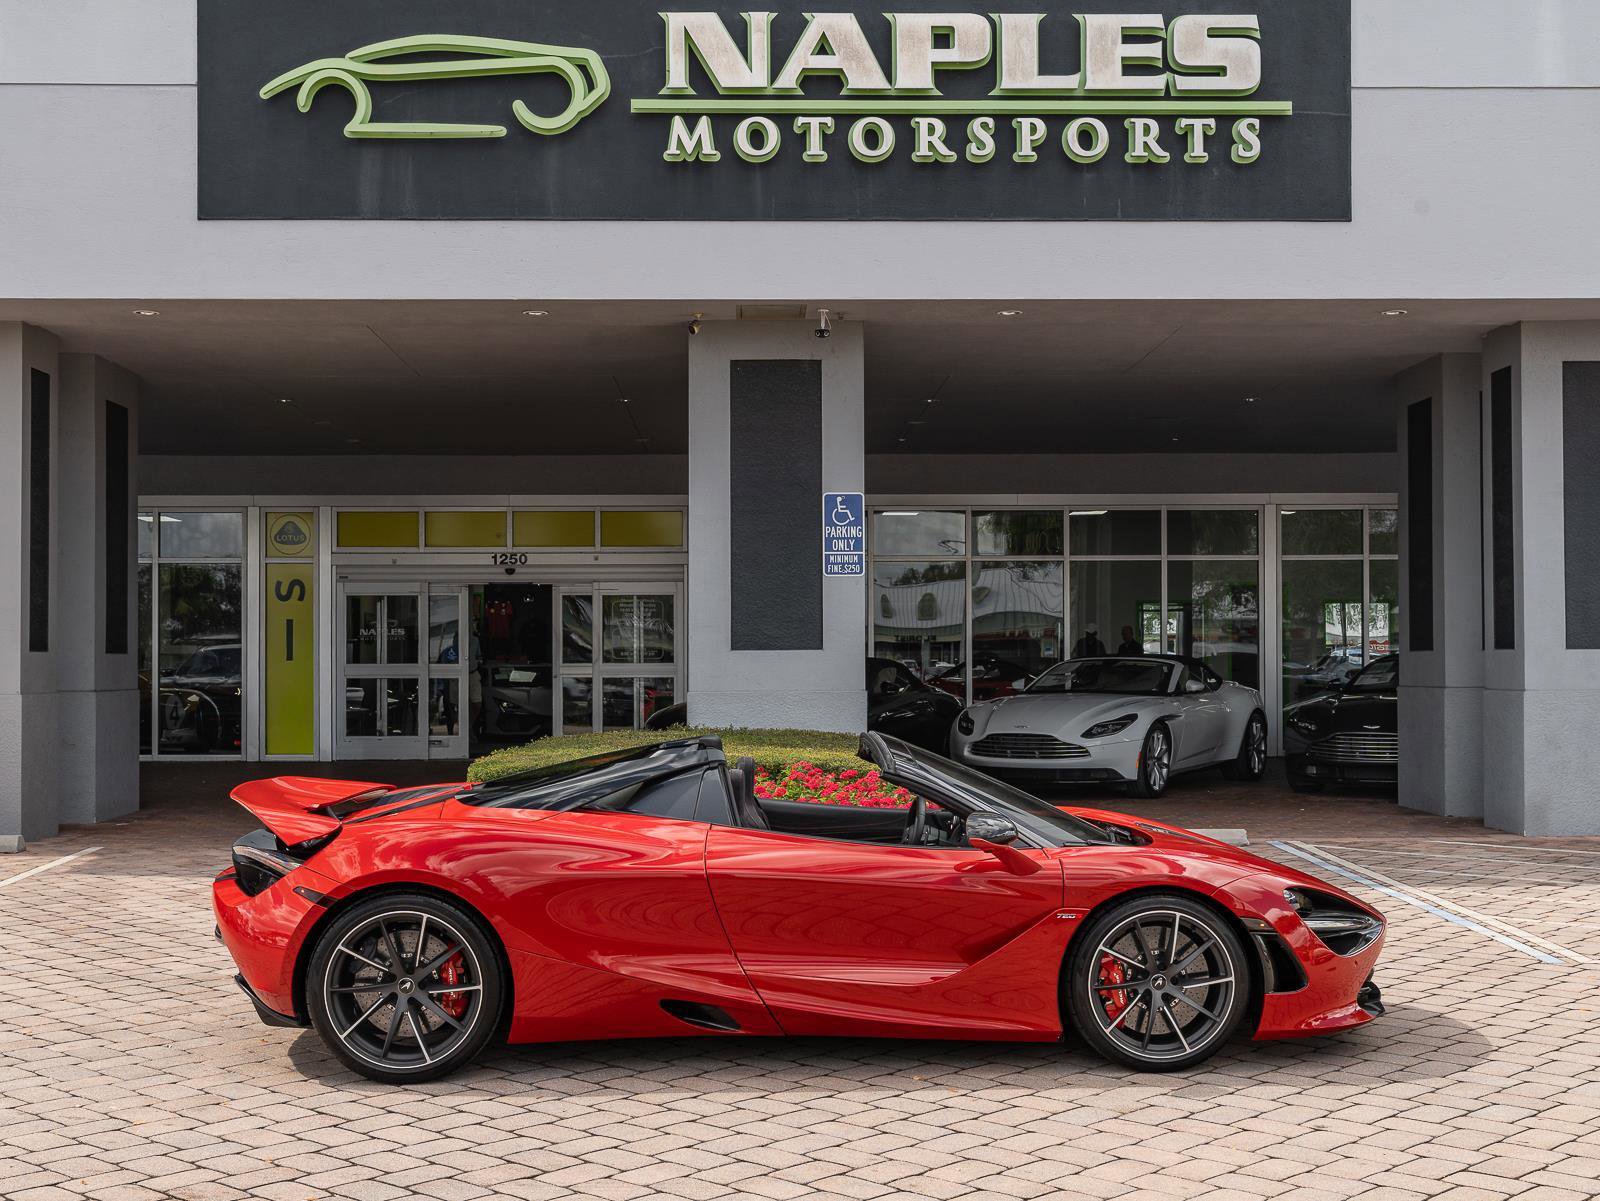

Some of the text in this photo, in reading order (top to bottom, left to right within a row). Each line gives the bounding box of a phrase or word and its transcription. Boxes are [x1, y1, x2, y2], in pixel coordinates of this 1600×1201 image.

[657, 11, 1262, 96] NAPLES
[662, 115, 1262, 164] MOTORSPORTS
[276, 534, 305, 542] LOTUS
[825, 526, 863, 538] PARKING
[832, 539, 856, 551] ONLY
[491, 553, 528, 565] 1250
[829, 554, 858, 563] MINIMUM
[359, 628, 406, 636] NALES
